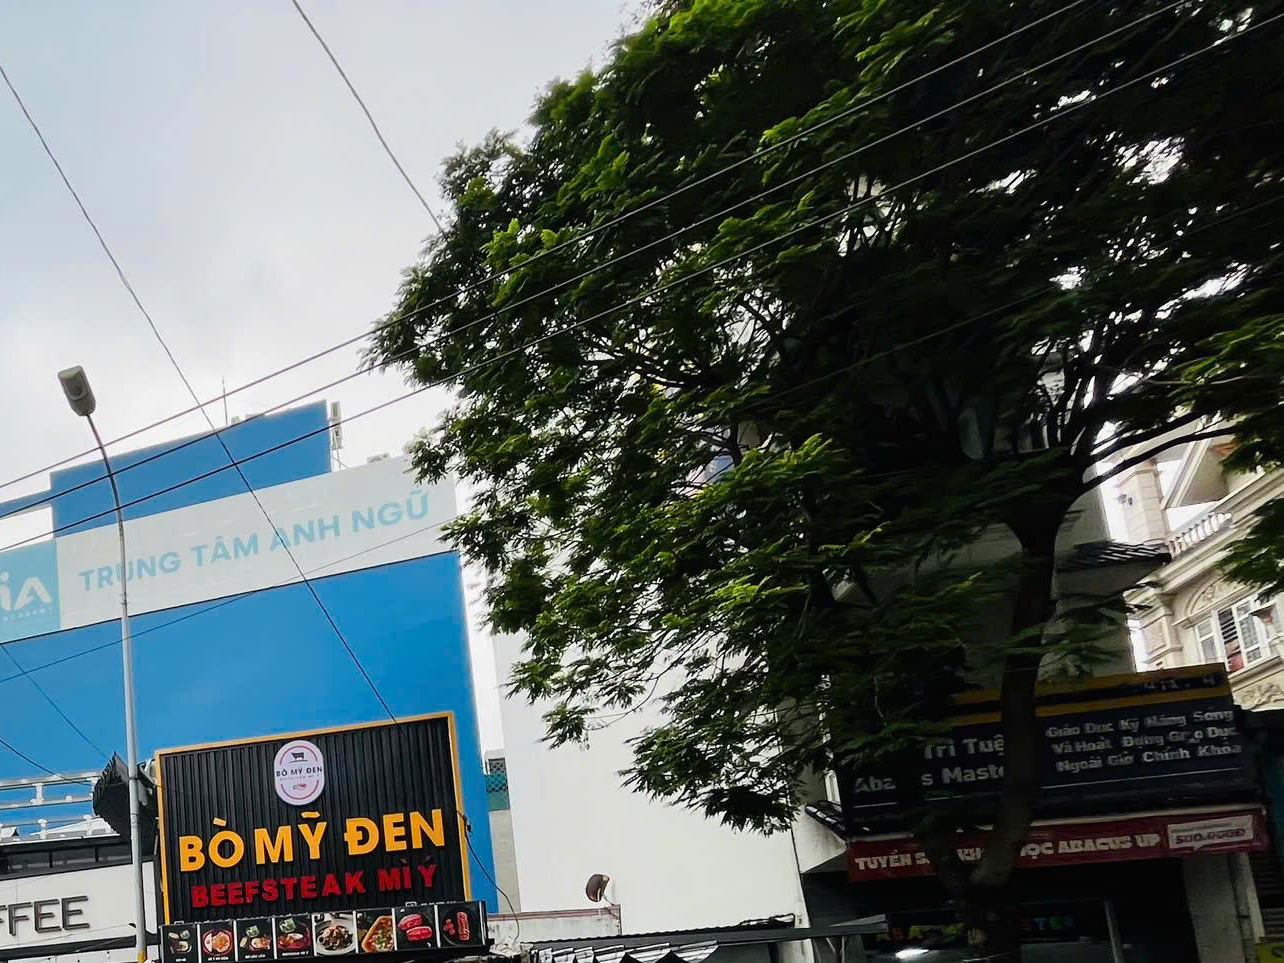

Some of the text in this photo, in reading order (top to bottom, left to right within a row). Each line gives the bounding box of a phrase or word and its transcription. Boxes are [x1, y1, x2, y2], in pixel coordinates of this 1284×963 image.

[78, 489, 429, 592] TRUNG TÂM ANH NGỮ
[178, 808, 445, 872] BÒ MỸ ĐEN
[1058, 836, 1134, 854] ABACUS
[1135, 833, 1160, 848] UP
[190, 870, 365, 909] BEEFSTEAK
[378, 856, 411, 891] MÌ
